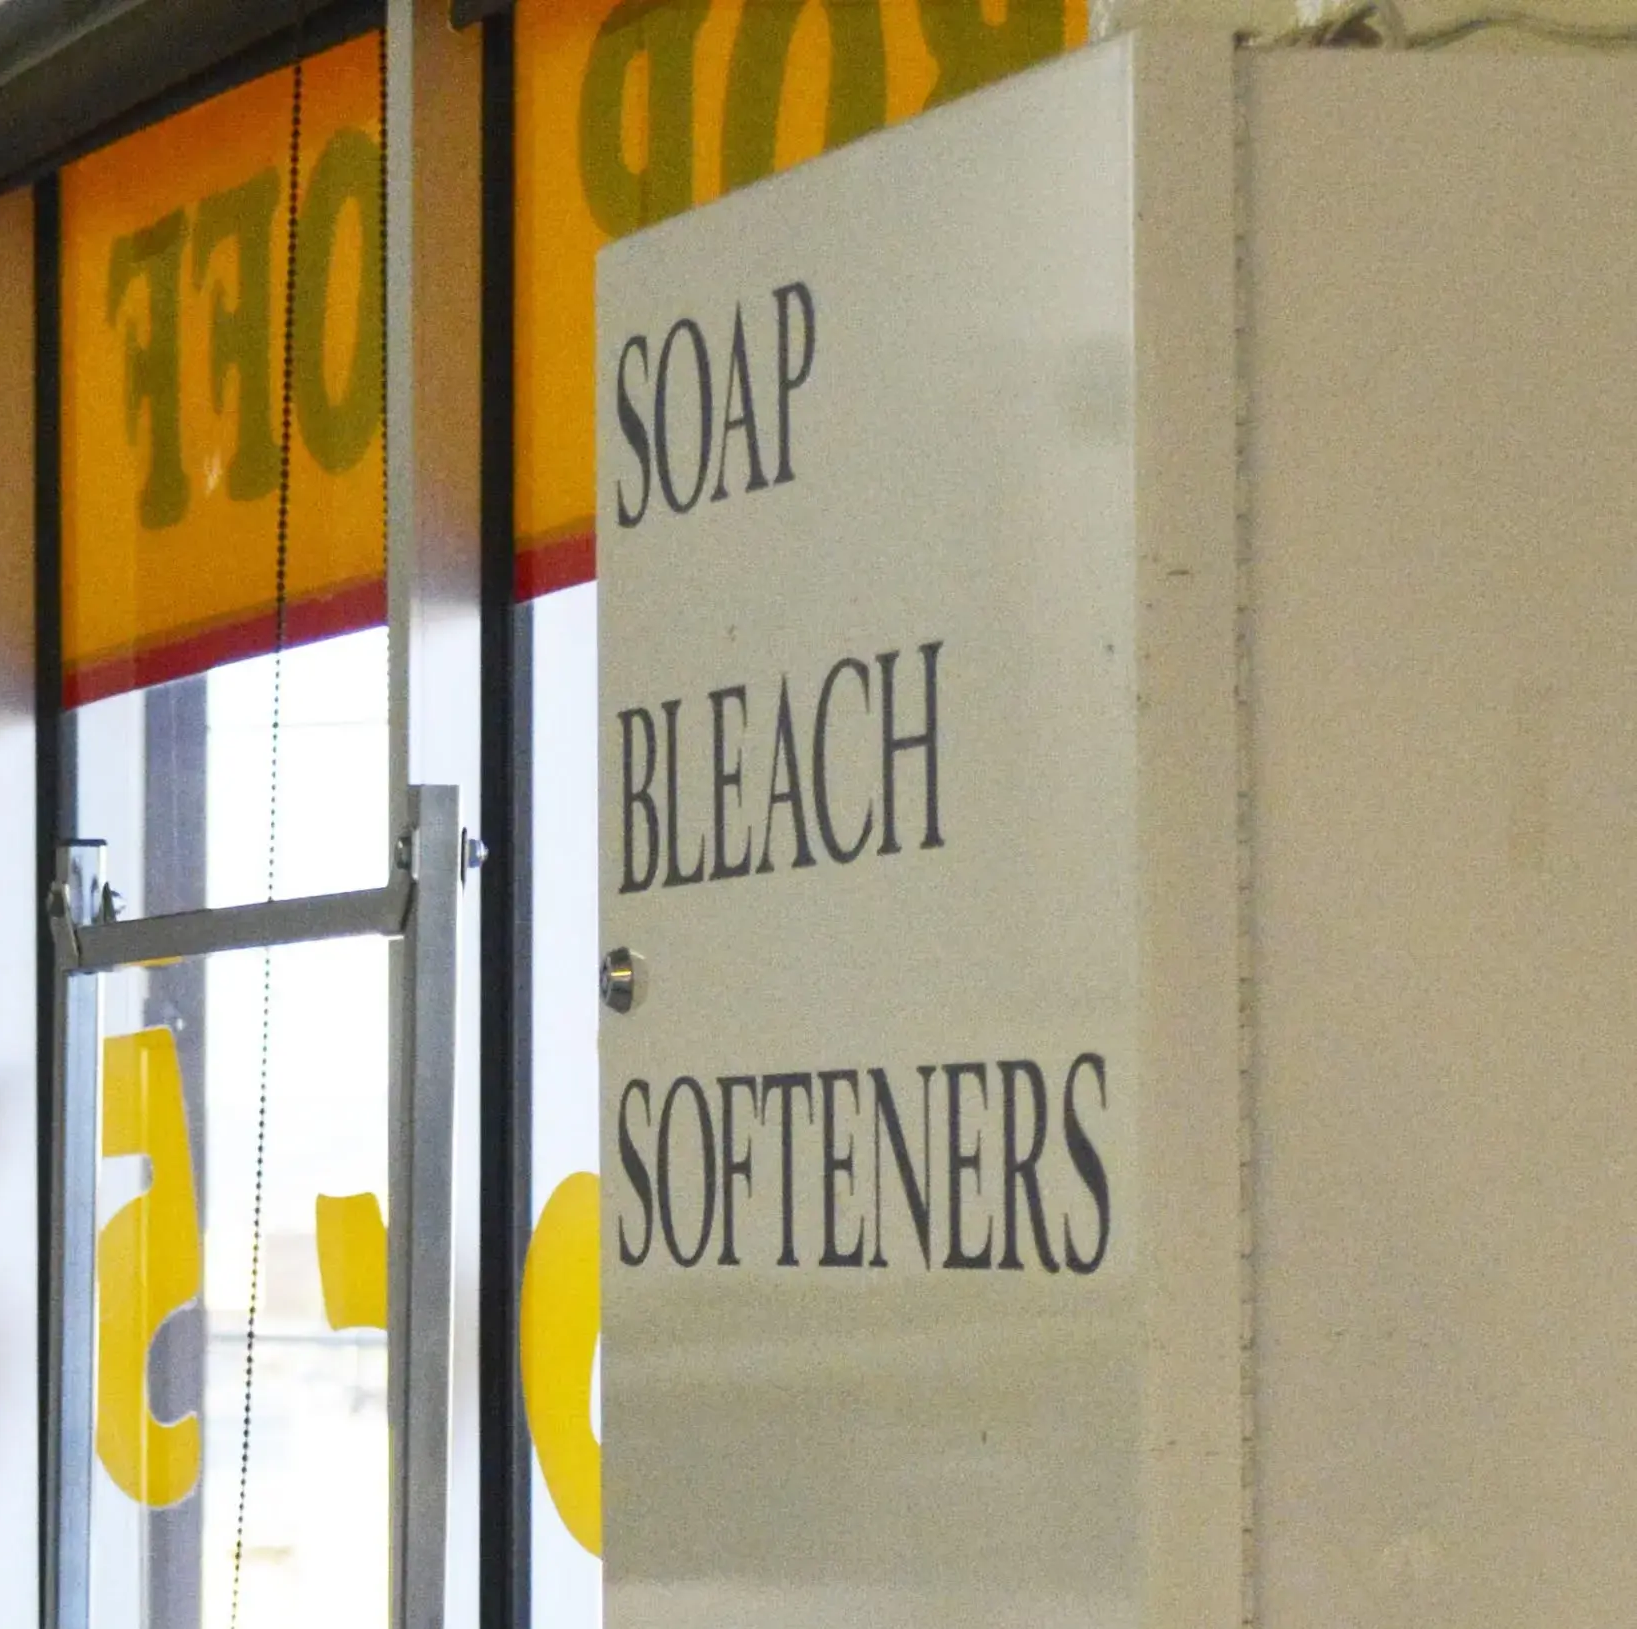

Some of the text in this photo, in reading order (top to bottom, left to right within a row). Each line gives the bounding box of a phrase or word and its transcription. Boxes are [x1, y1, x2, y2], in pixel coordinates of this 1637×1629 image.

[616, 280, 816, 529] SOAP
[617, 640, 946, 894] BLEACH
[617, 1052, 1111, 1275] SOFTENERS
